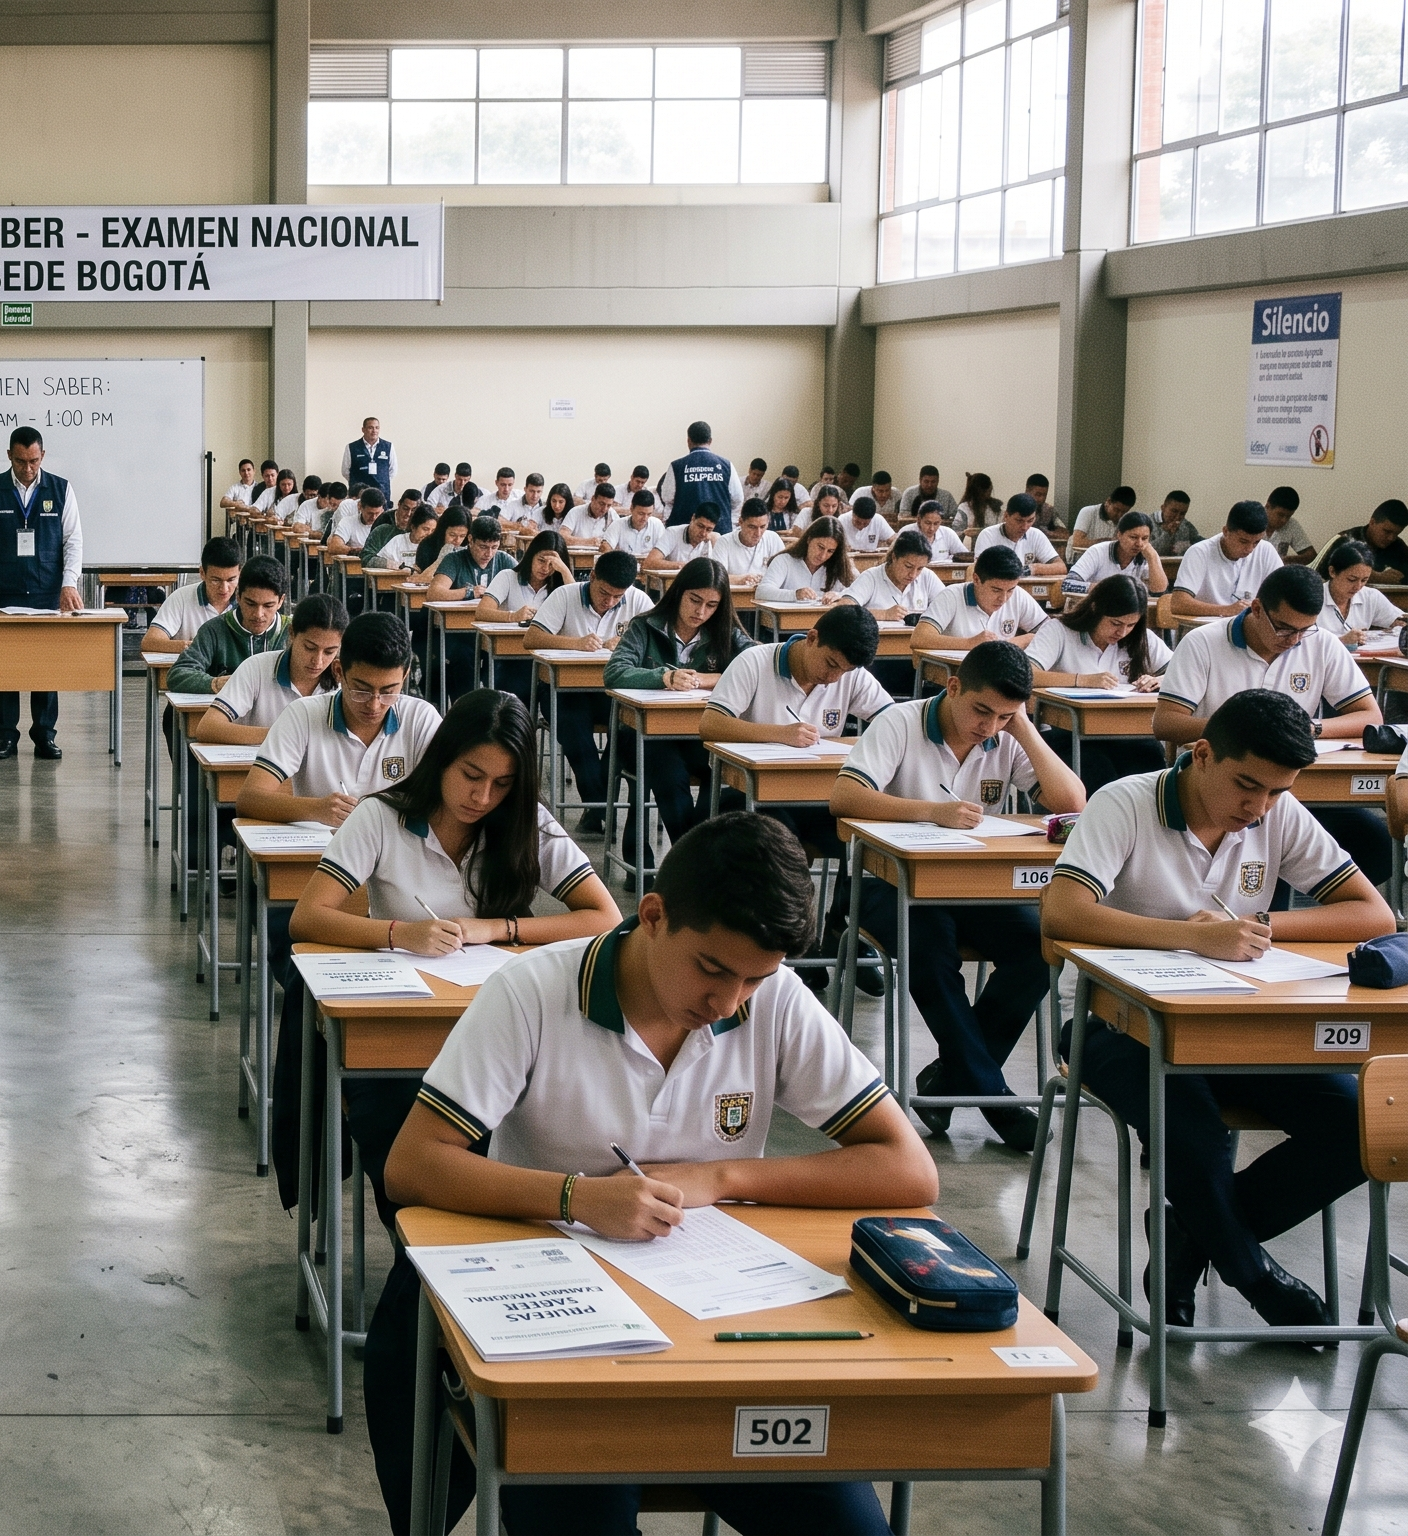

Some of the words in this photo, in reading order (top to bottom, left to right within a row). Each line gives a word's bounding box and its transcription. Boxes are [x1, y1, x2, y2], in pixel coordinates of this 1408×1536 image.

[102, 217, 238, 248] EXAMEN
[251, 216, 419, 247] NACIONAL
[77, 252, 210, 292] BOGOTÁ
[43, 376, 110, 396] SABER:
[45, 409, 83, 427] 1:00
[91, 412, 114, 427] PM
[1357, 780, 1381, 790] 201
[1021, 871, 1049, 884] 106
[1323, 1027, 1361, 1045] 209
[750, 1418, 811, 1445] 502
